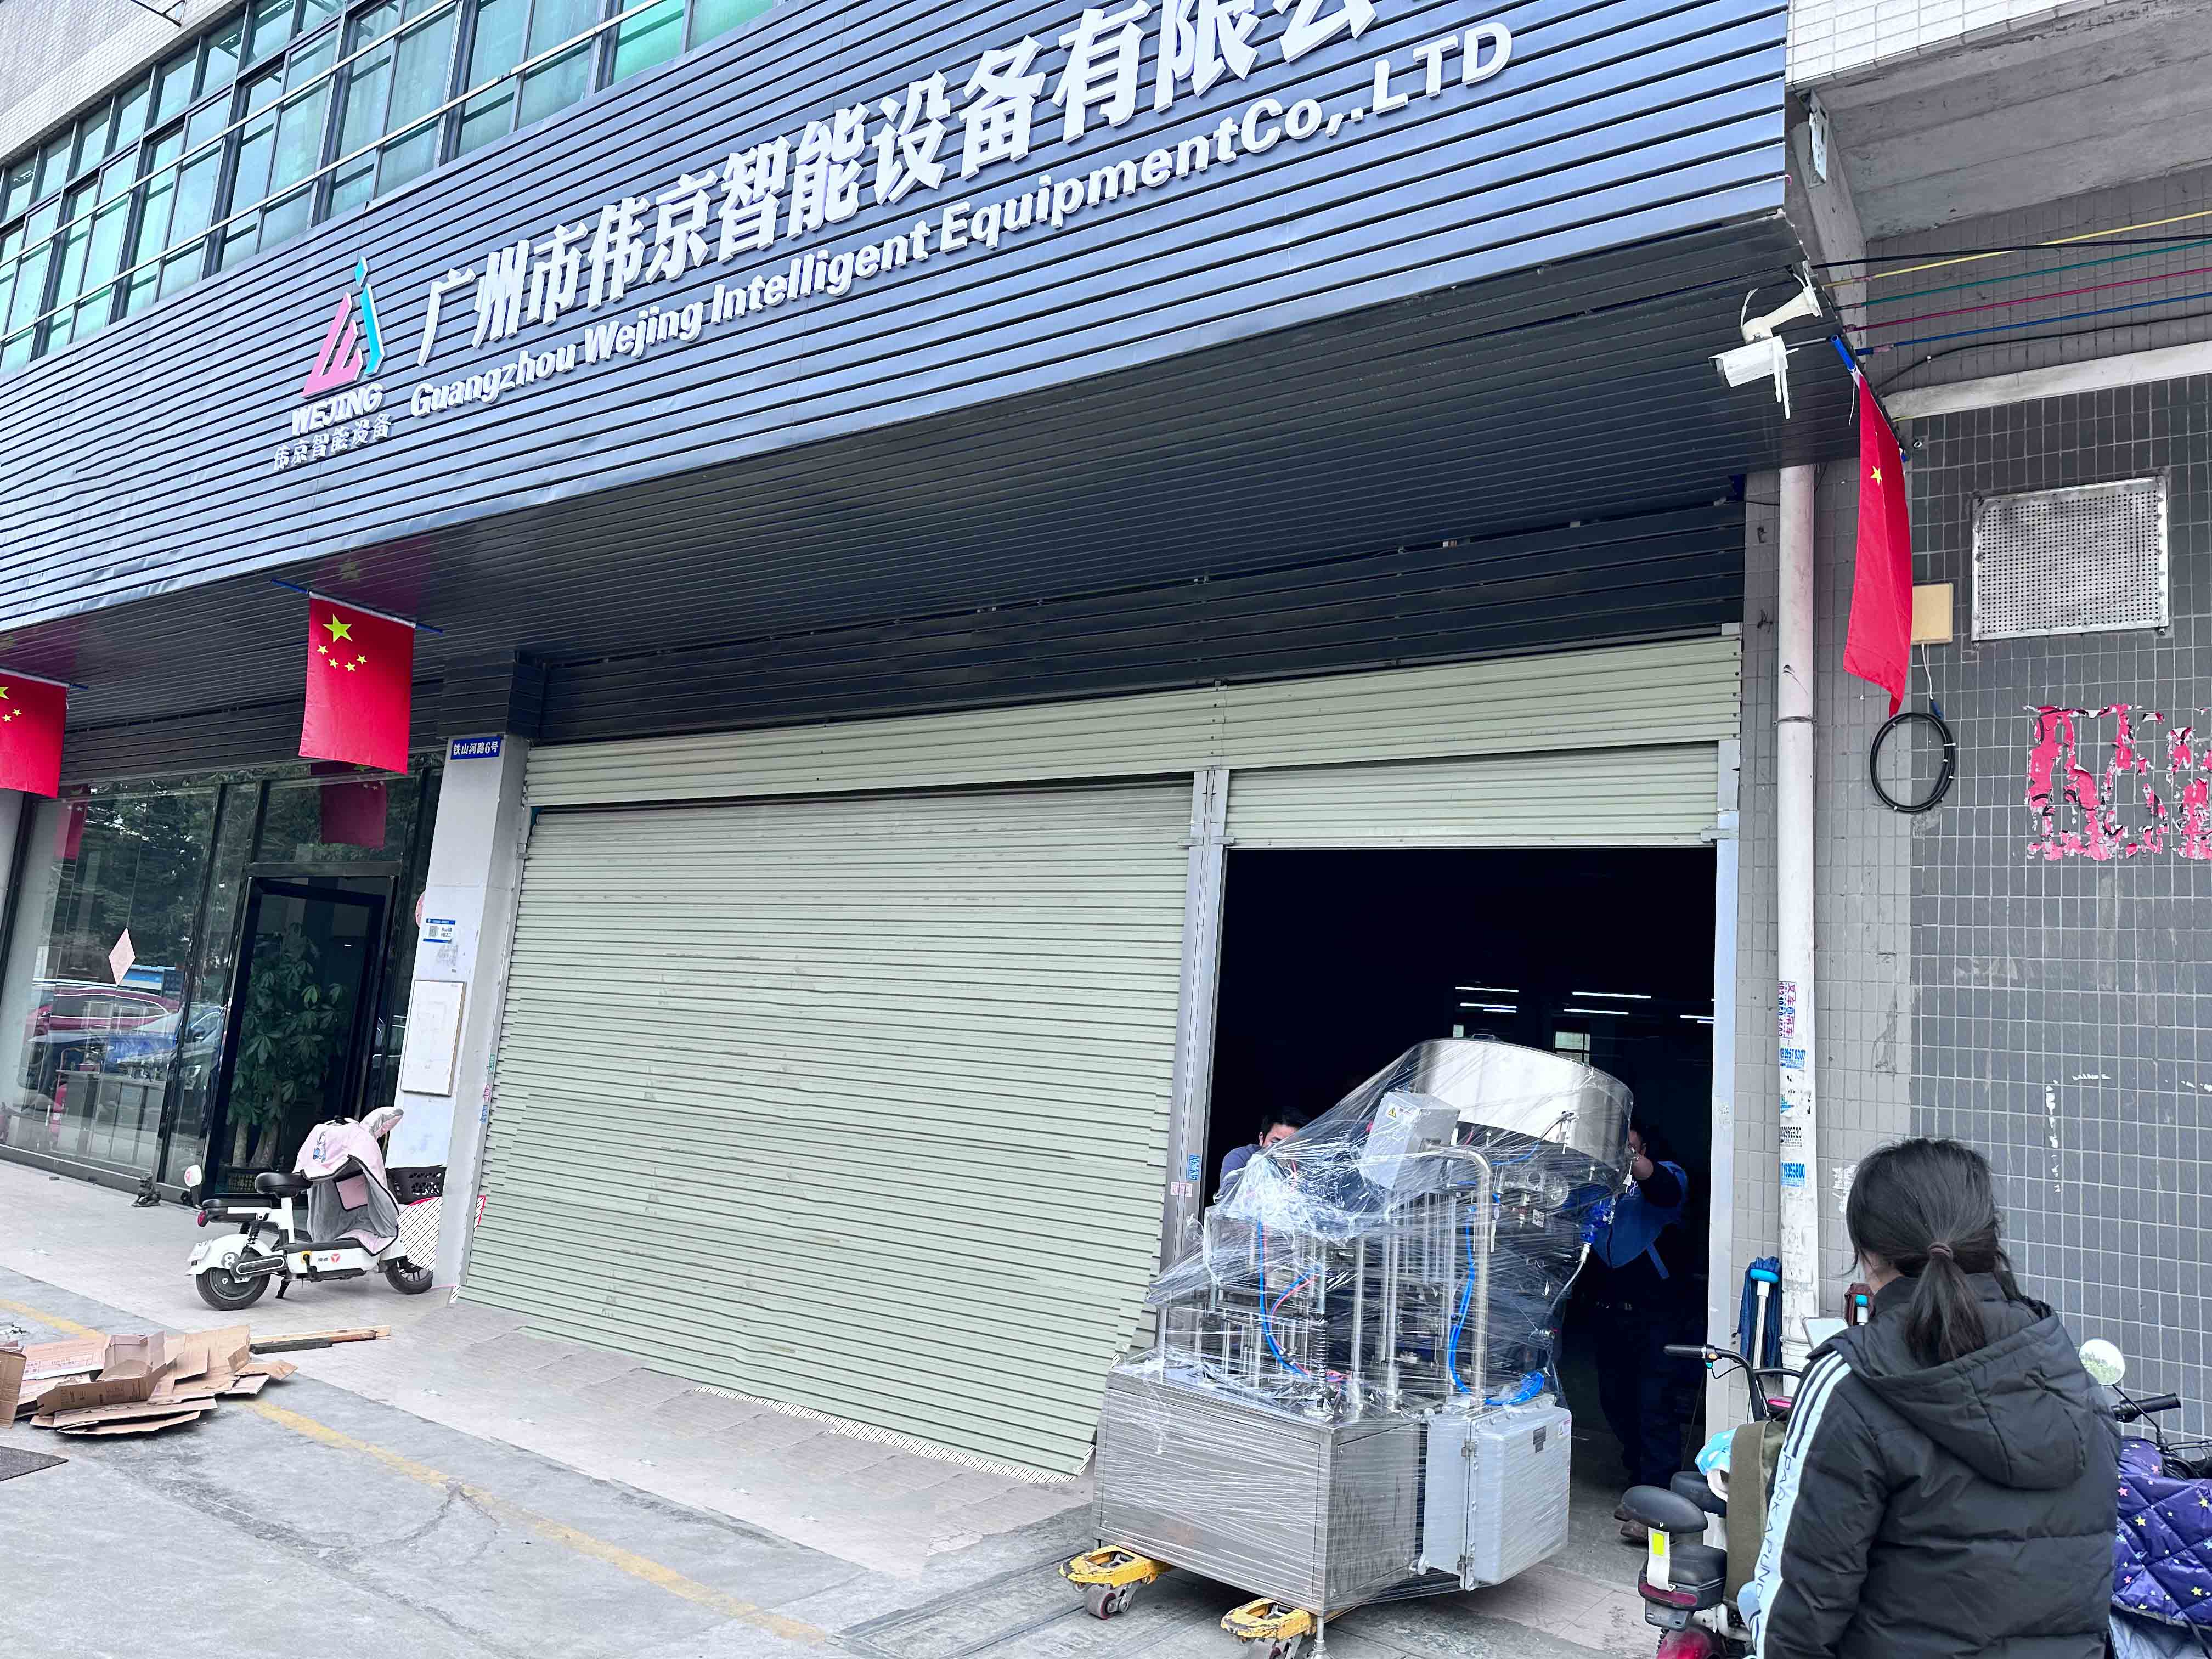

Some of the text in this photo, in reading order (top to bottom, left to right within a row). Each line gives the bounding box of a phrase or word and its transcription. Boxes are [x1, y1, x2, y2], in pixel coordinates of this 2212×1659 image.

[410, 344, 577, 417] Guangzhou
[584, 301, 703, 364] Wejing
[710, 219, 930, 324] Intelligent
[292, 383, 383, 436] WEJING
[274, 413, 392, 471] 伟京智能设备
[453, 740, 498, 755] 铁山河路6号
